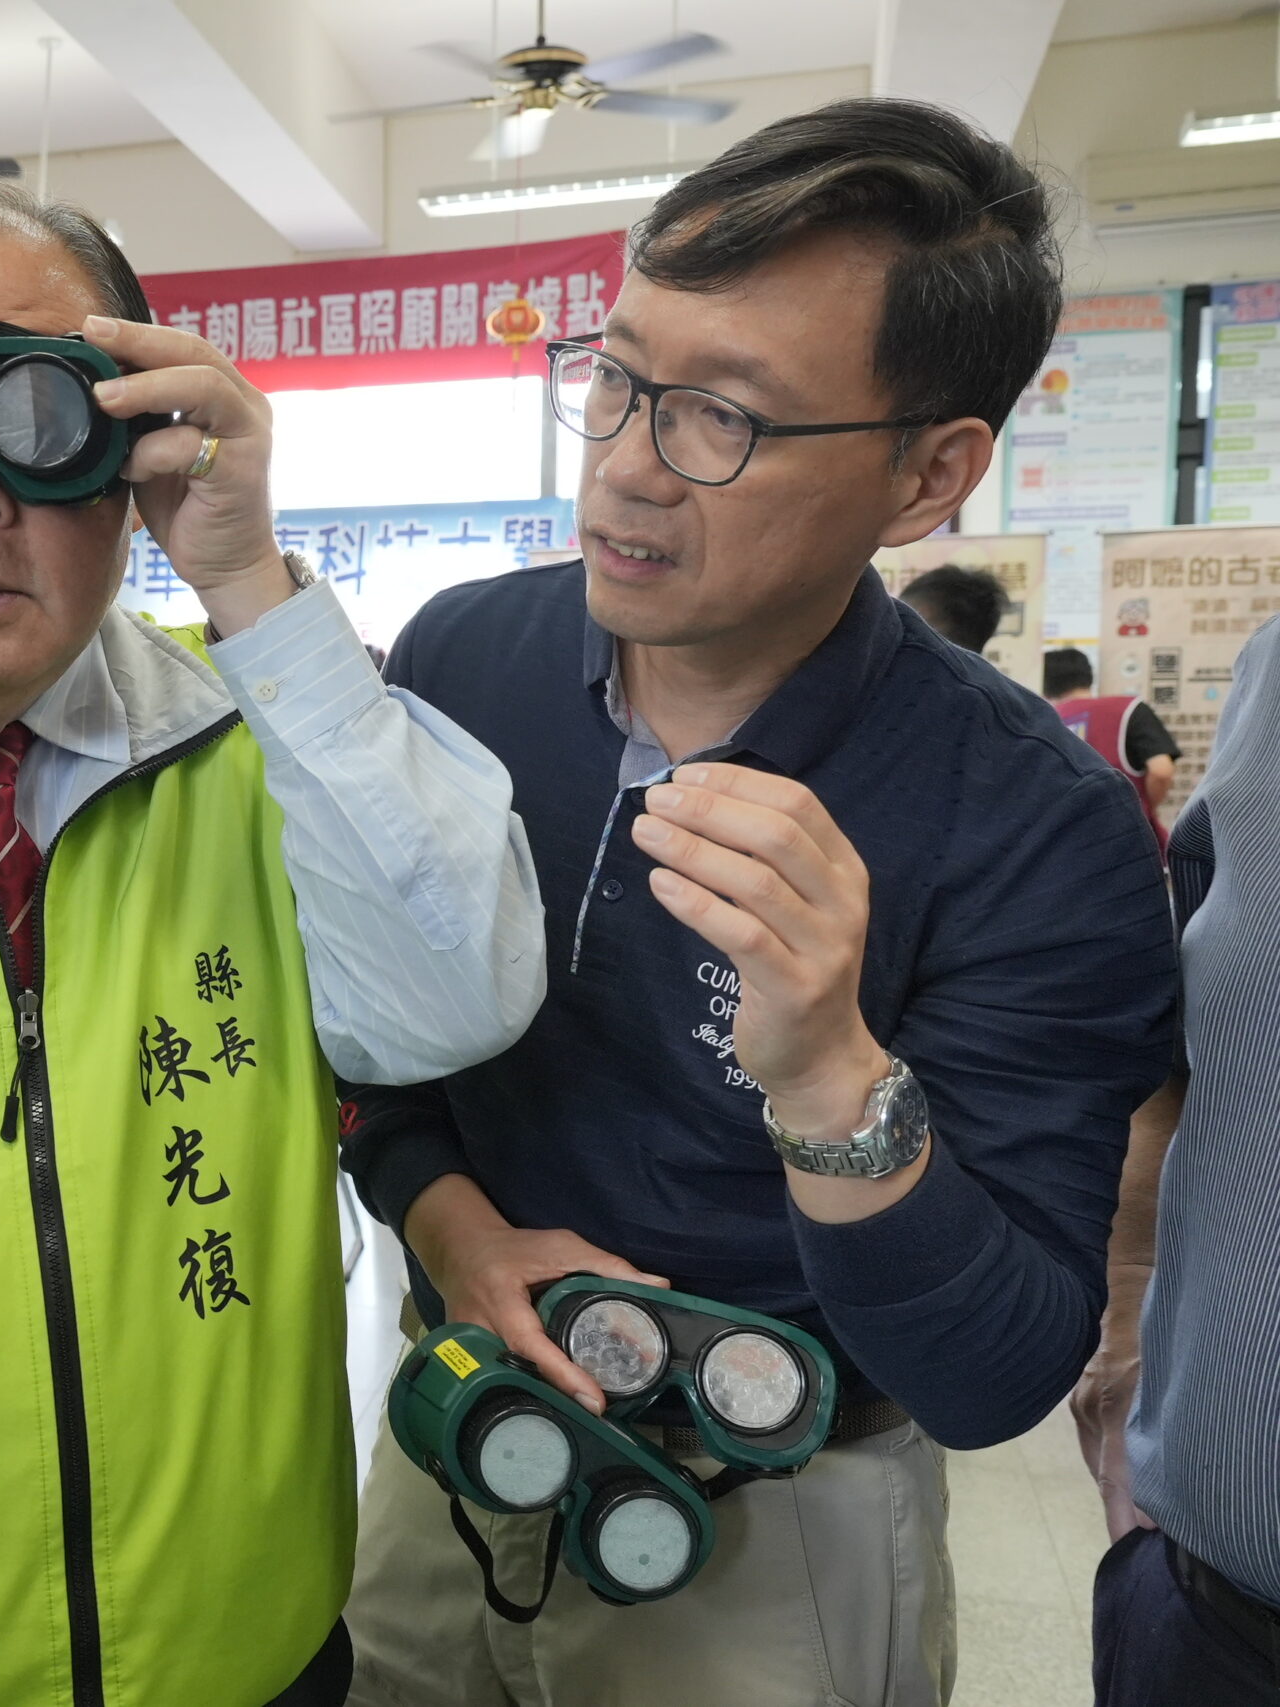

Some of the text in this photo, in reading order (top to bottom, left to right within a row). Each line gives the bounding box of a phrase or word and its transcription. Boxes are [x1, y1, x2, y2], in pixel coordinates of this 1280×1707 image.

[194, 944, 257, 1078] 縣長
[138, 1014, 252, 1320] 陳光復
